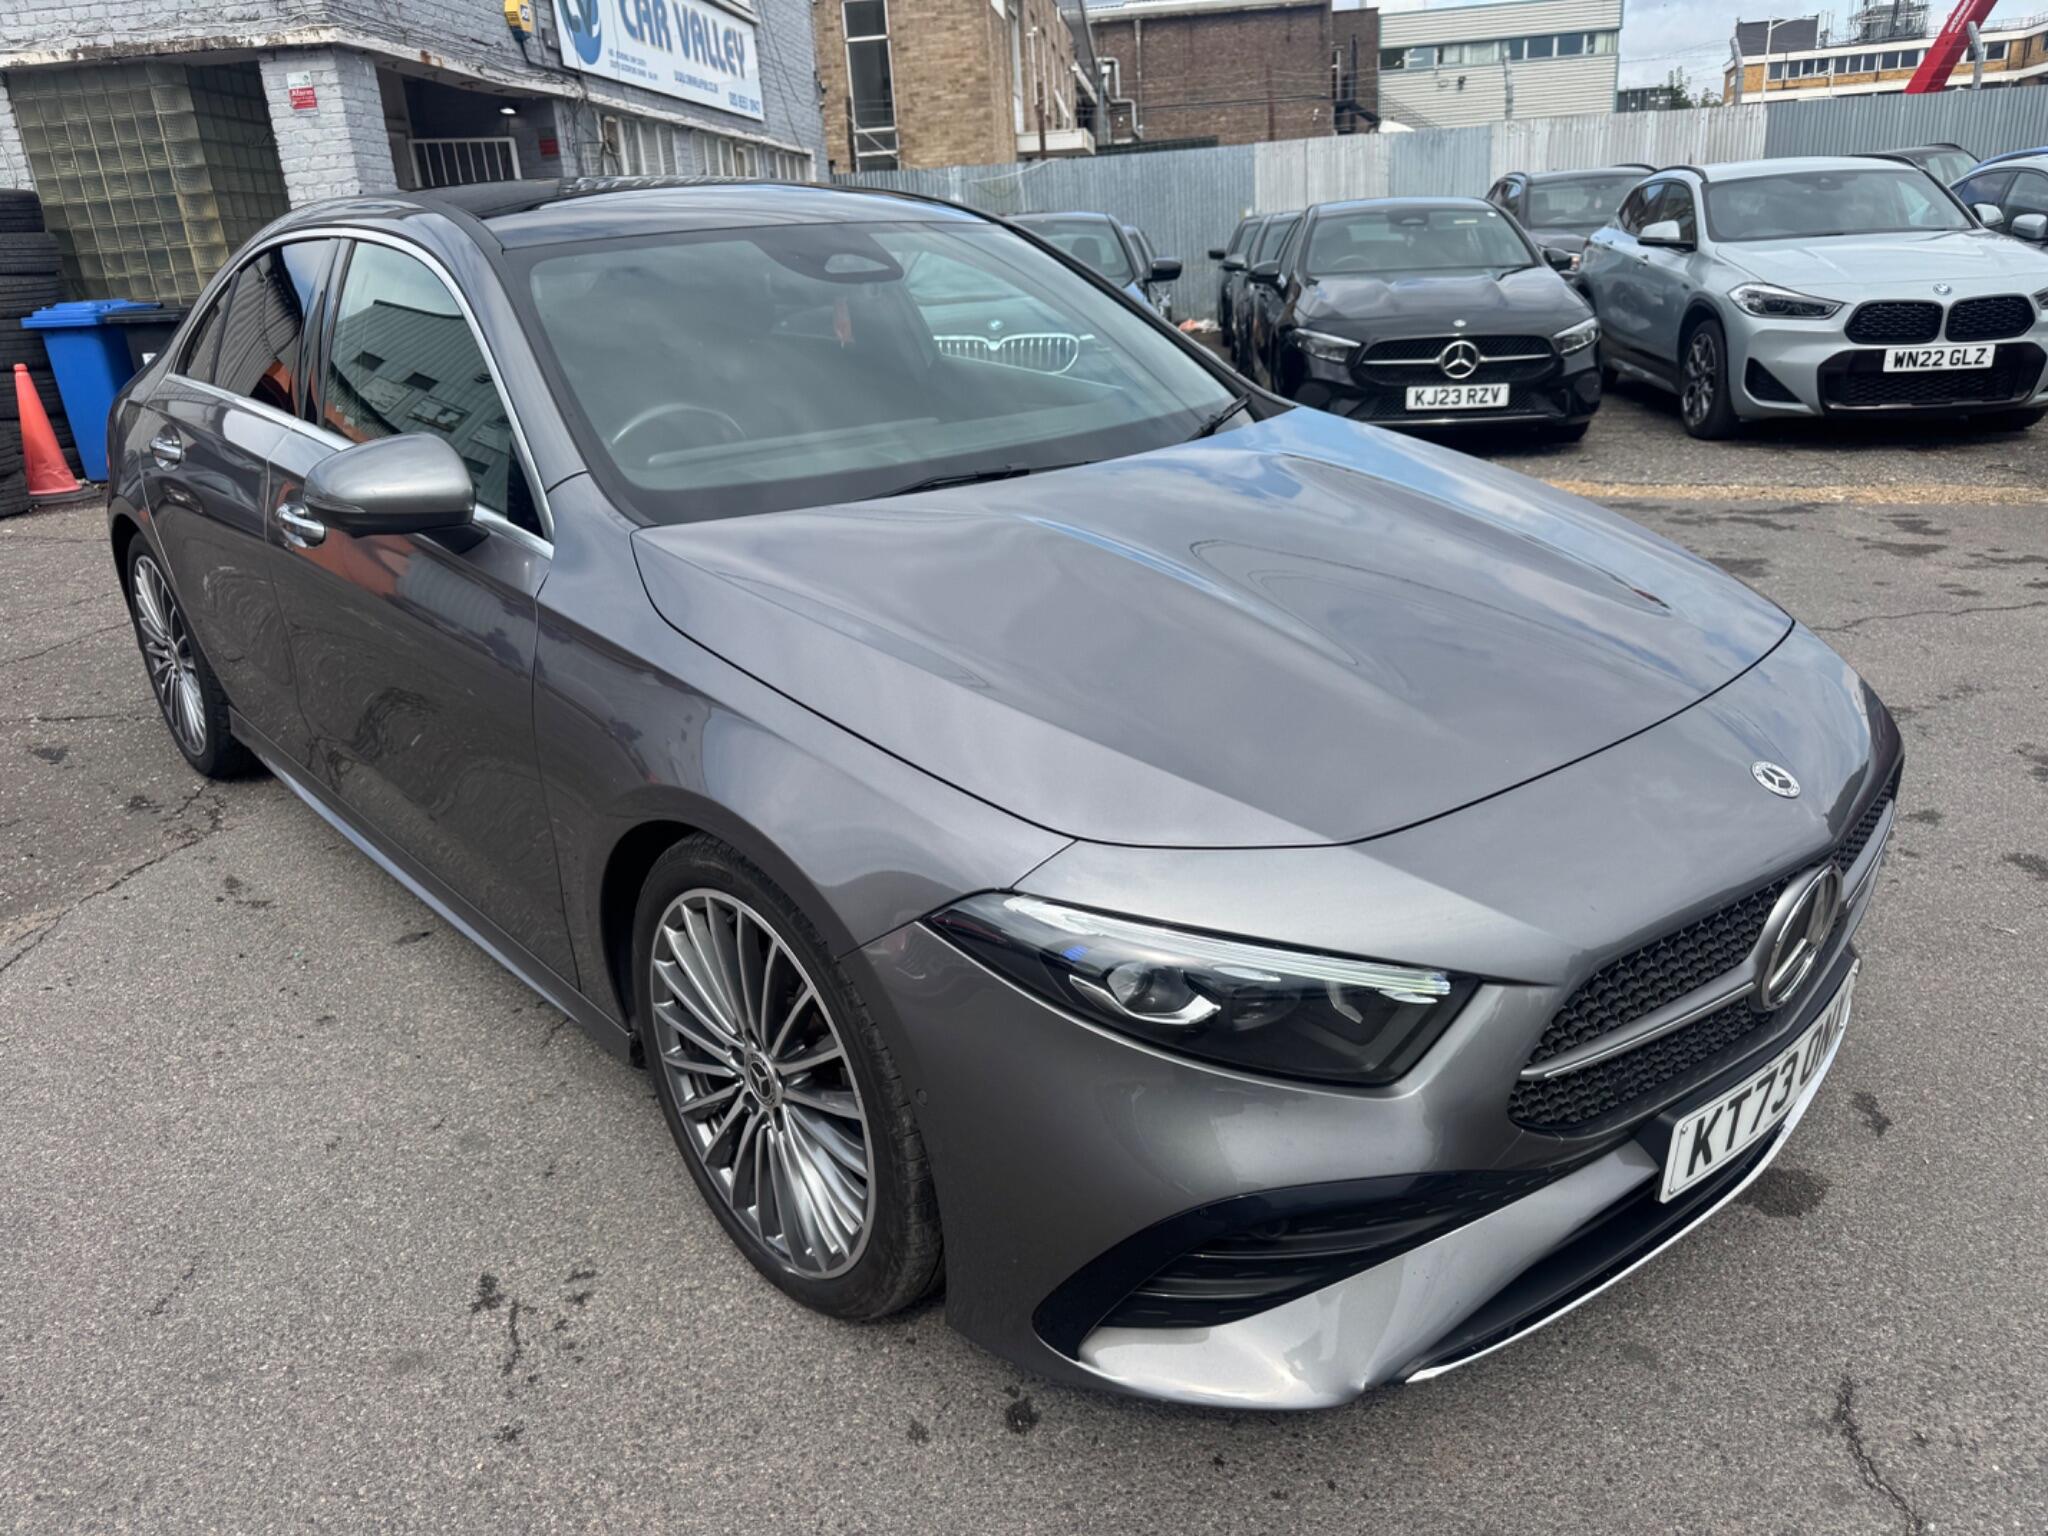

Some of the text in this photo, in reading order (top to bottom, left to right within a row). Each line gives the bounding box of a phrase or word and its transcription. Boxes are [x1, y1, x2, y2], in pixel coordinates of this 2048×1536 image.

[618, 0, 746, 78] CAR VALLEY
[1893, 347, 1987, 369] WN22 GLZ
[1413, 387, 1501, 406] KJ23 RZV
[1686, 1050, 1800, 1178] KT73
